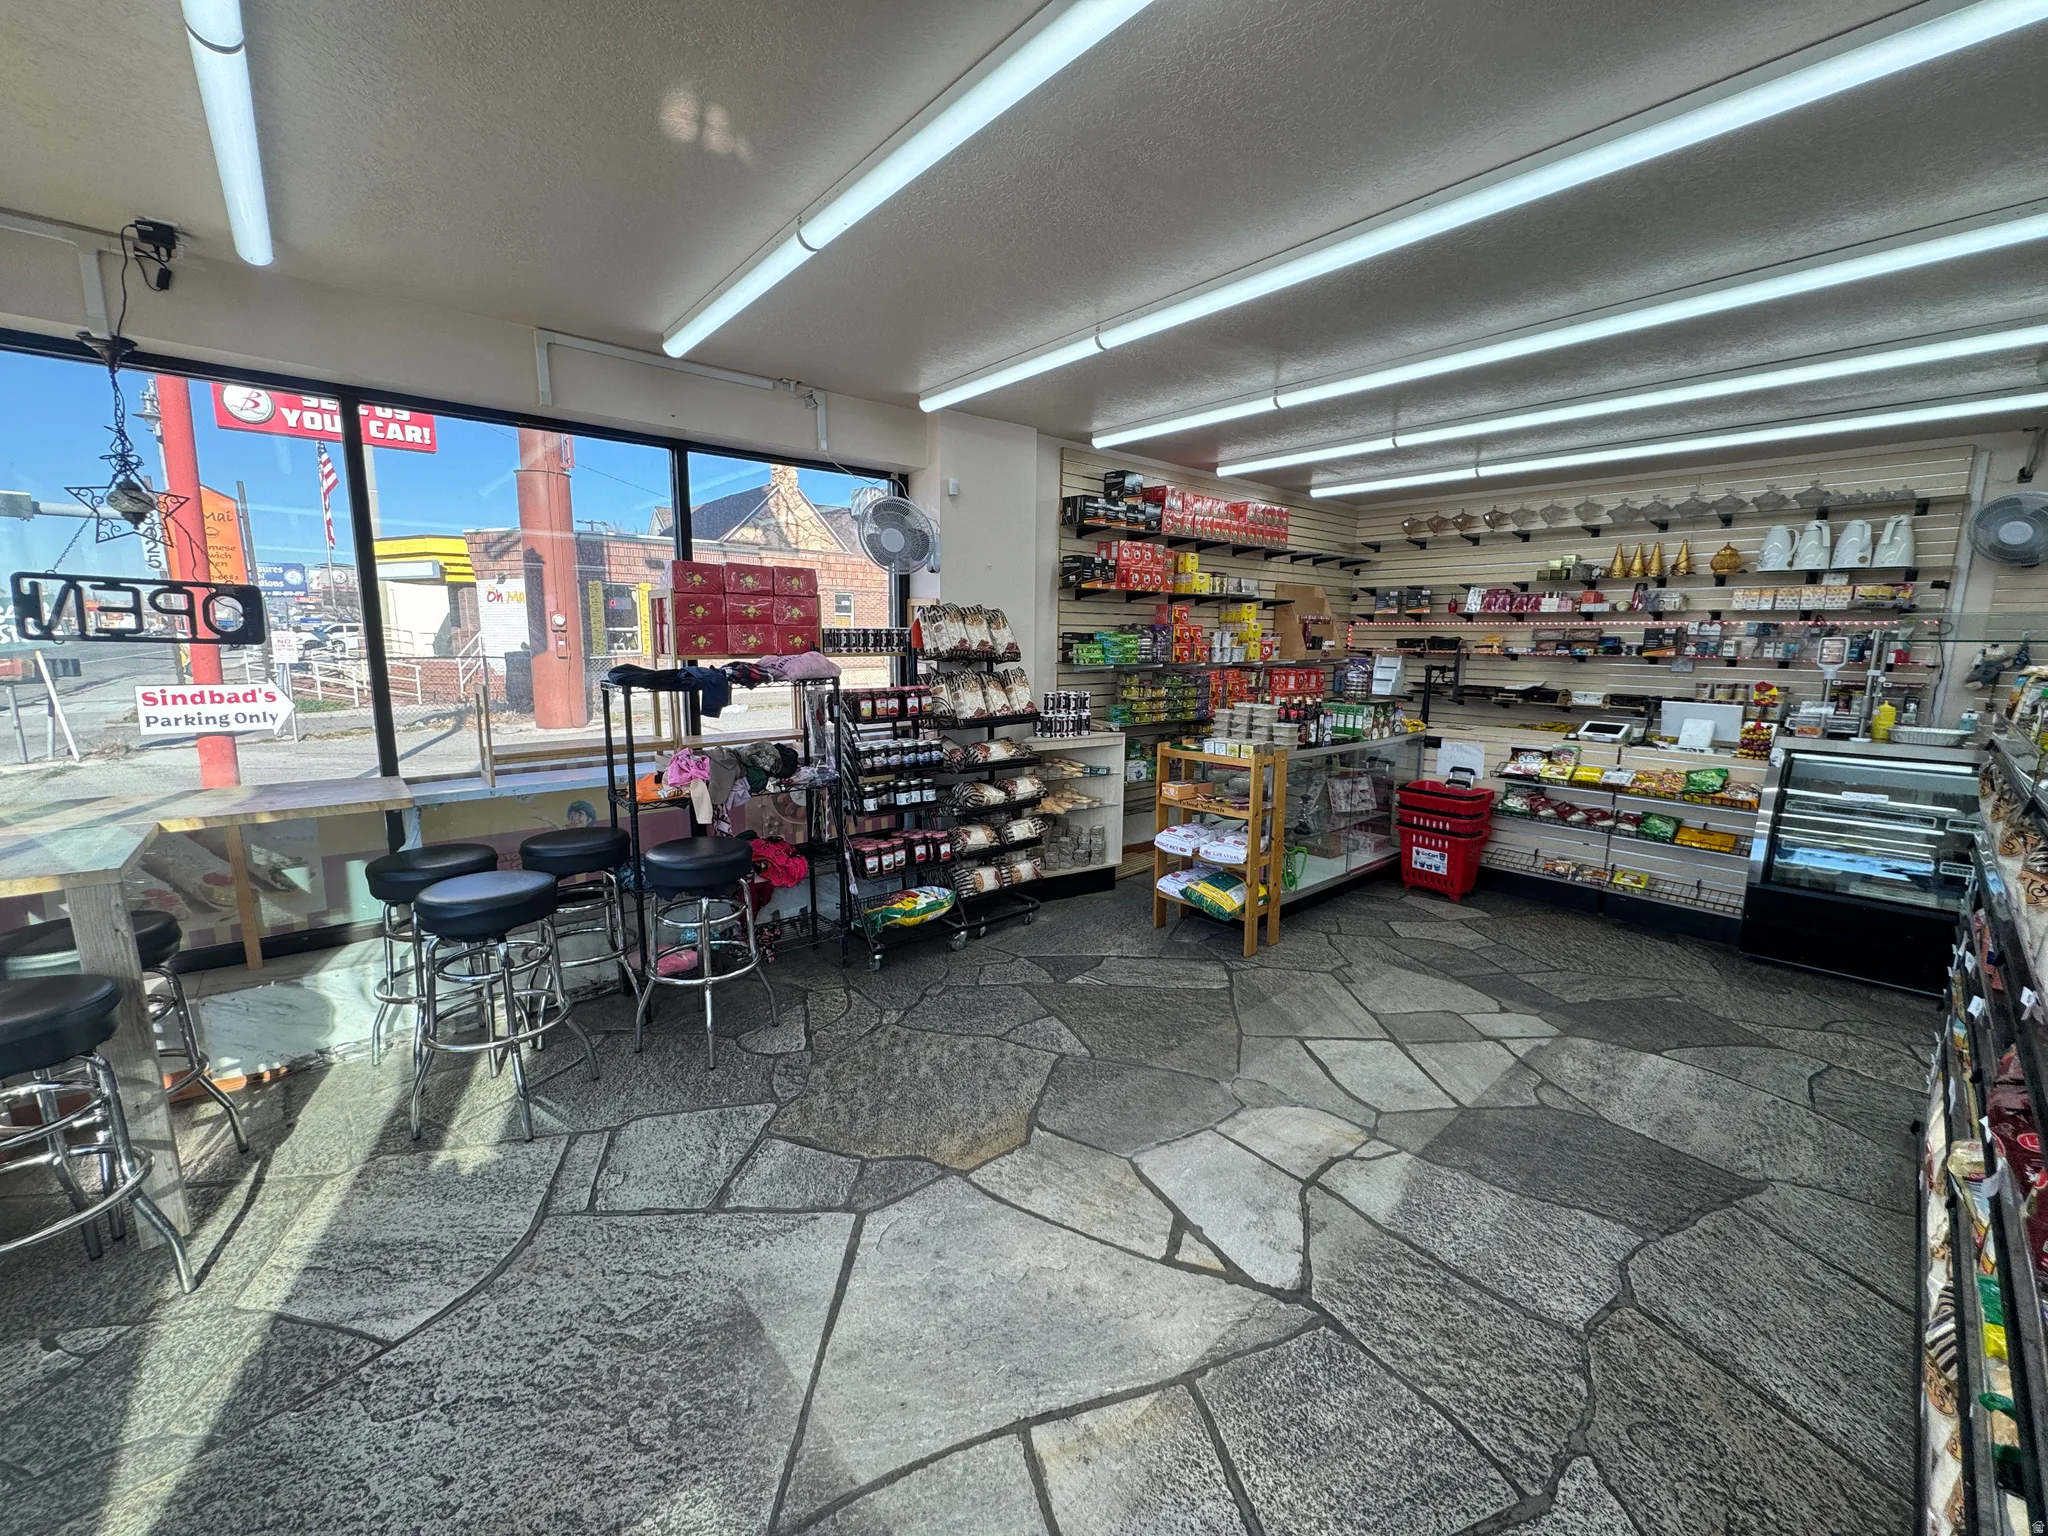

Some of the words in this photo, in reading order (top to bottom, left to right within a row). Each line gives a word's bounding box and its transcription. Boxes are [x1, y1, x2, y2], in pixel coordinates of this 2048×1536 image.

[280, 407, 342, 433] YOU
[369, 420, 431, 445] CAR!
[208, 551, 232, 560] wich
[487, 588, 503, 603] Oh
[141, 688, 277, 707] Sindbad's
[145, 712, 231, 728] Parking
[234, 711, 279, 725] Only
